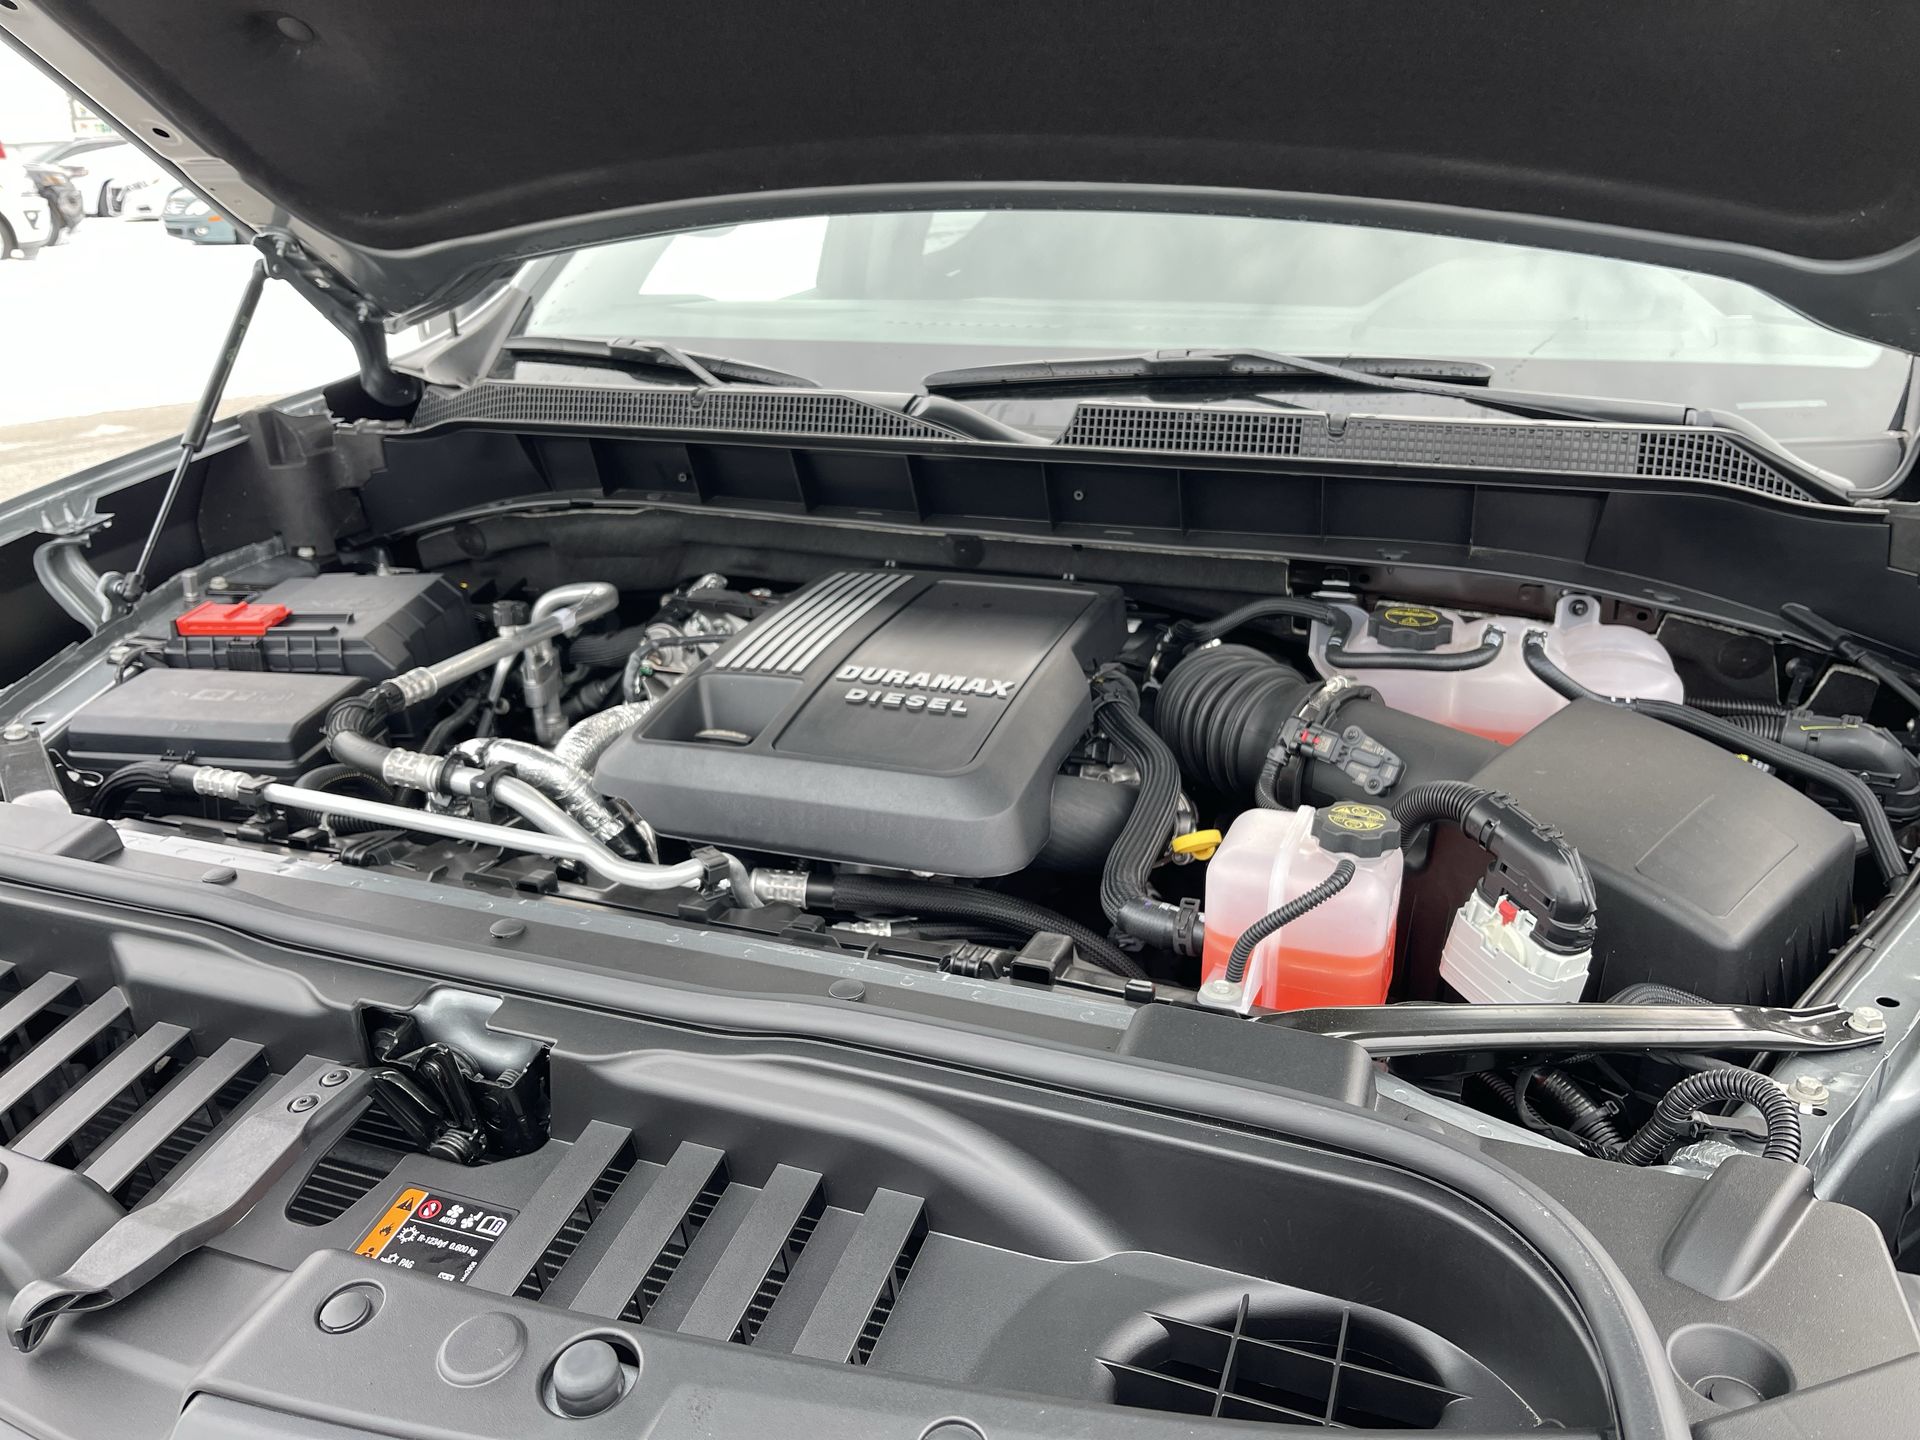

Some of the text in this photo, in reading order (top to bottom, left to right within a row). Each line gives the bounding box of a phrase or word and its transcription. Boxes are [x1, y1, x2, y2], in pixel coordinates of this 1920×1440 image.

[836, 665, 1015, 699] DURAMAX
[845, 688, 967, 716] DIESEL
[439, 1216, 457, 1226] AUTO
[448, 1242, 469, 1254] 0.600
[467, 1247, 478, 1257] kg
[398, 1258, 415, 1269] PAG
